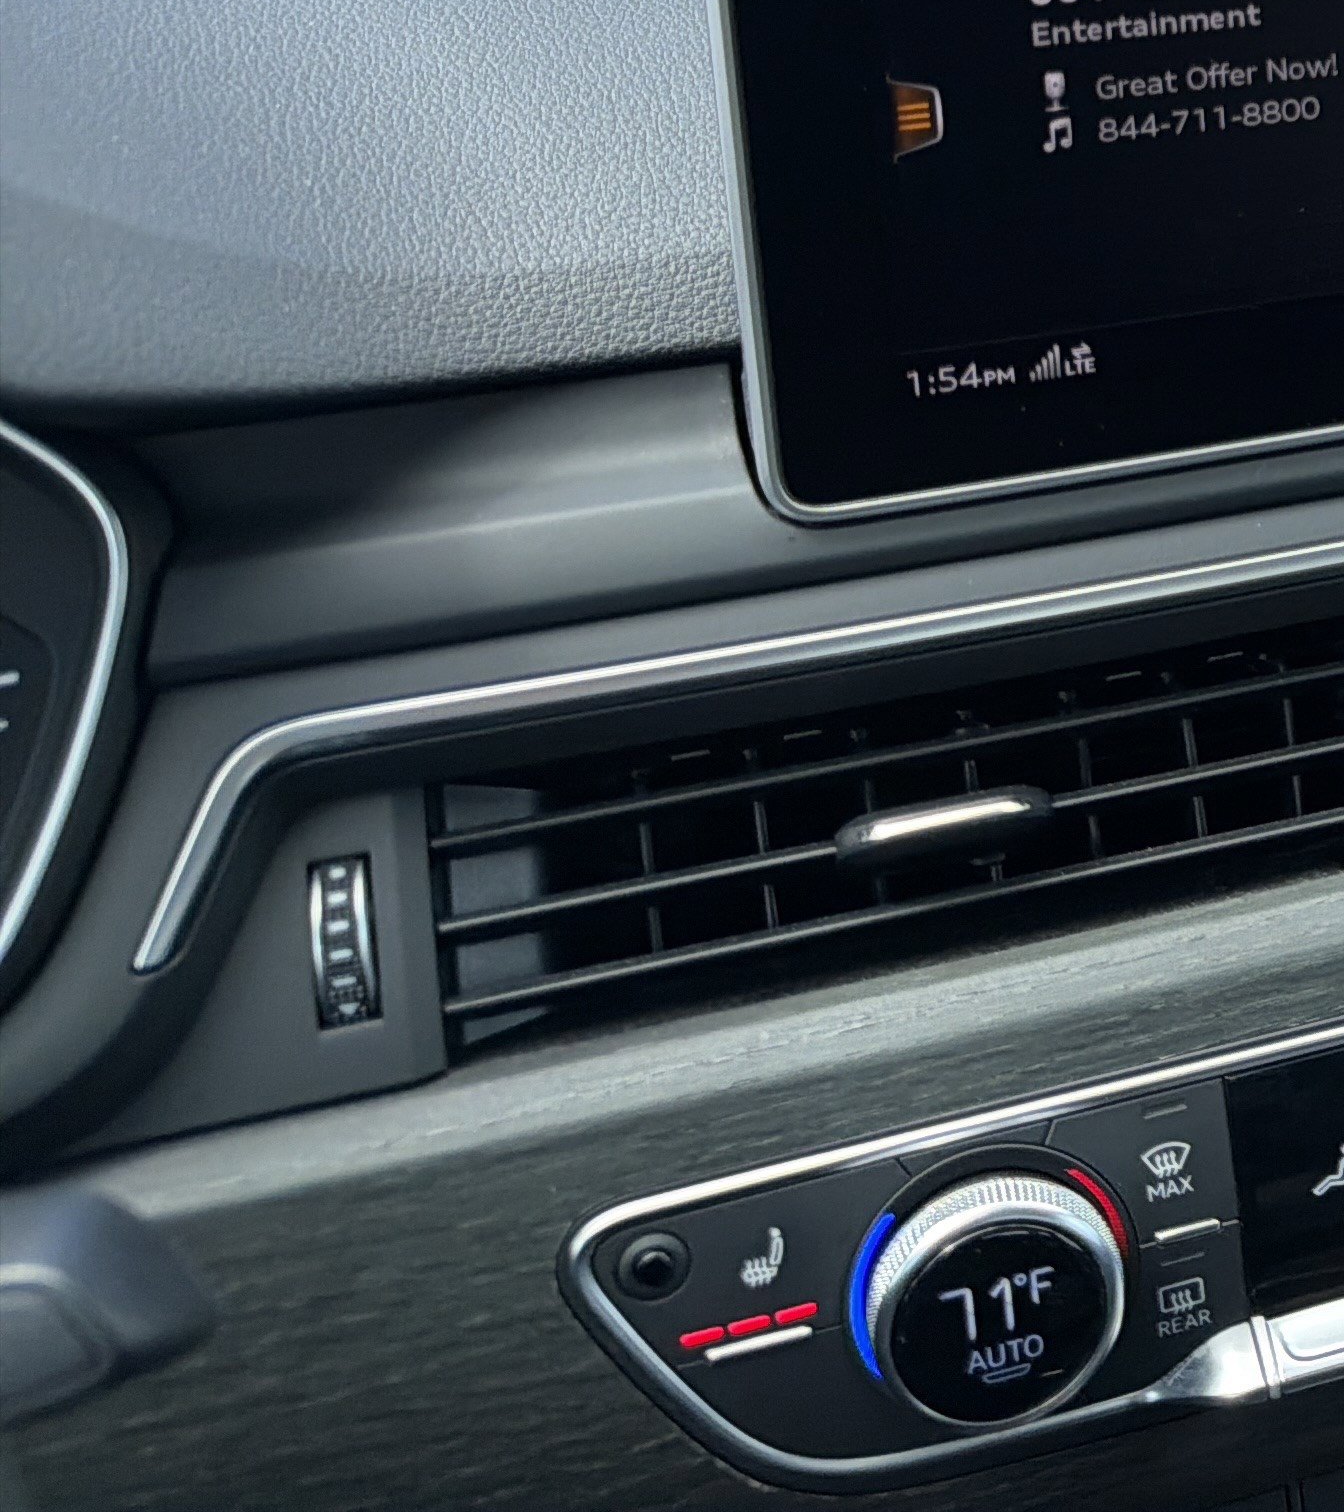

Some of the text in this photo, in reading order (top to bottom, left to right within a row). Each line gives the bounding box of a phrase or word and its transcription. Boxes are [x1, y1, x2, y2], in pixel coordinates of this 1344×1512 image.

[1031, 2, 1262, 46] Entertainment
[1096, 52, 1340, 101] Great Offer Now!
[1098, 96, 1321, 144] 844-711-8800
[1064, 357, 1097, 376] LTE
[1146, 1174, 1195, 1203] MAX
[1157, 1309, 1213, 1337] REAR
[967, 1335, 1045, 1373] AUTO
